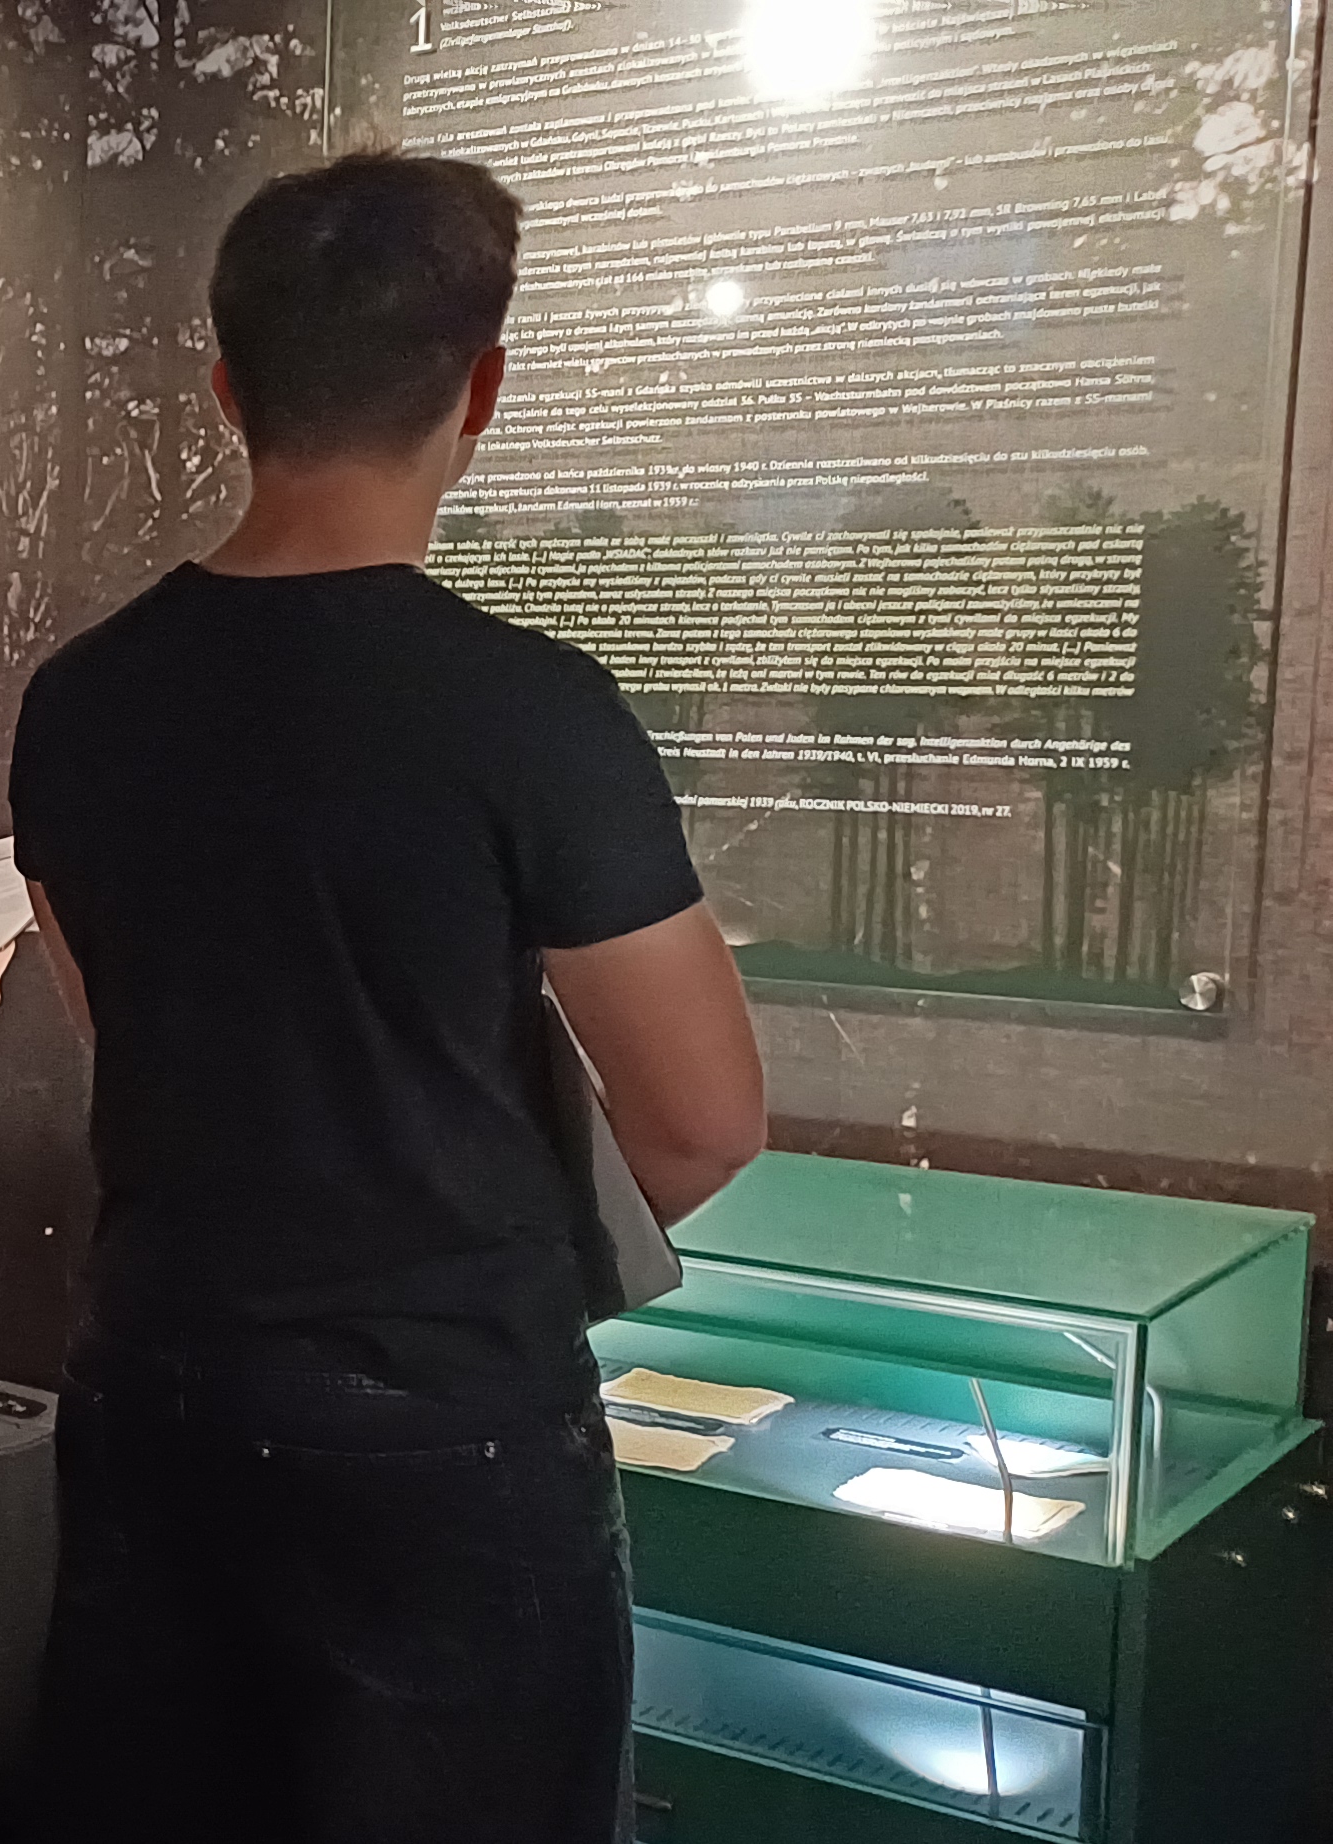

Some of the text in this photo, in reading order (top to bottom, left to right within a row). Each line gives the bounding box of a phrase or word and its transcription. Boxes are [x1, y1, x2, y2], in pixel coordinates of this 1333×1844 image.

[550, 407, 562, 415] do
[789, 392, 802, 403] SS
[505, 424, 543, 434] Ochronę
[487, 472, 541, 482] prowadzono
[543, 470, 555, 479] od
[557, 468, 584, 478] końca
[733, 461, 759, 471] 1940
[769, 459, 813, 470] Dziennie
[893, 455, 907, 465] od
[992, 451, 1007, 461] do
[478, 488, 497, 499] była
[543, 485, 587, 494] dokonana
[589, 483, 600, 493] 11
[602, 482, 645, 493] listopada
[647, 481, 671, 491] 1939
[557, 500, 594, 510] Edmund
[715, 733, 732, 741] von
[735, 731, 762, 742] Polen
[765, 733, 784, 742] und
[1110, 740, 1131, 751] des
[728, 747, 738, 758] in
[740, 748, 759, 758] den
[761, 749, 794, 759] Jahren
[962, 753, 1014, 765] Edmunda
[1071, 756, 1084, 767] IX
[1088, 757, 1119, 768] 1959
[749, 796, 773, 807] 1939
[799, 798, 844, 809] ROCZNIK
[846, 800, 948, 813] POLSKO-NIEMIECKI
